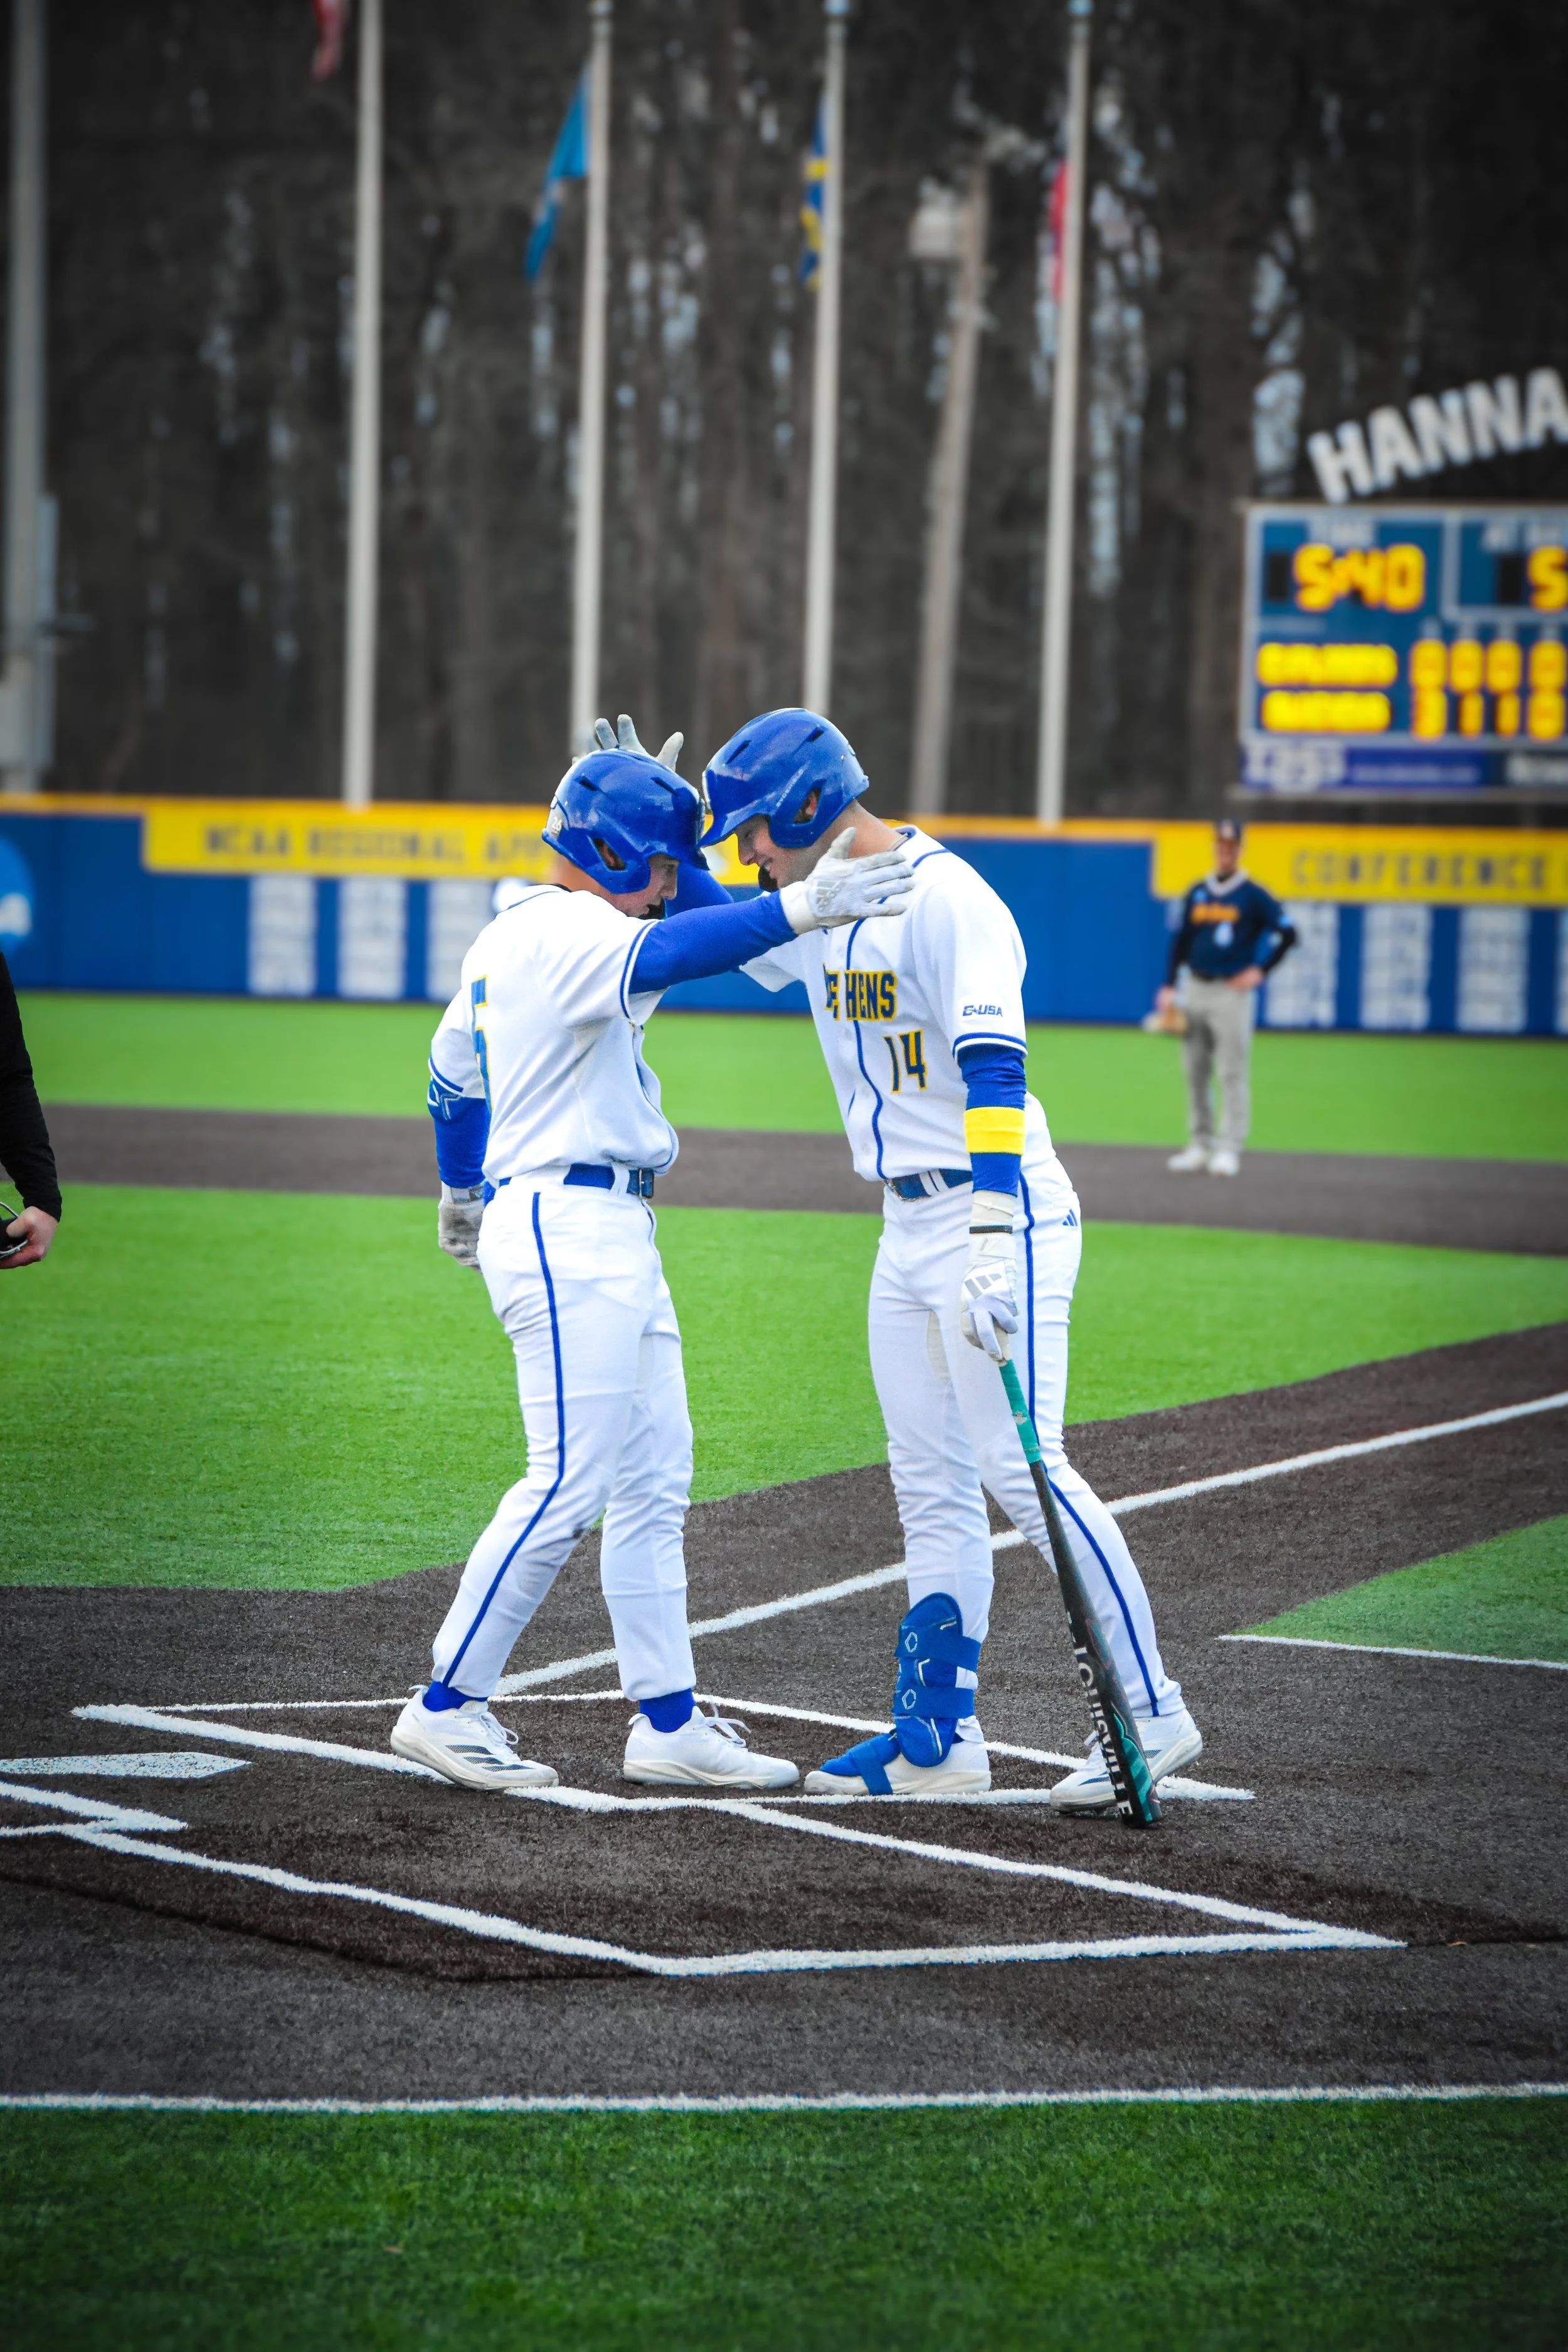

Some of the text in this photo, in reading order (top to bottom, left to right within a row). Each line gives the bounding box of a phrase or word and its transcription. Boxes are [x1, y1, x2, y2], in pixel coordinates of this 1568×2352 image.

[206, 824, 290, 857] NCAA
[1293, 849, 1552, 891] CONFERENCE
[844, 970, 897, 1021] HENS
[883, 1029, 927, 1094] 14
